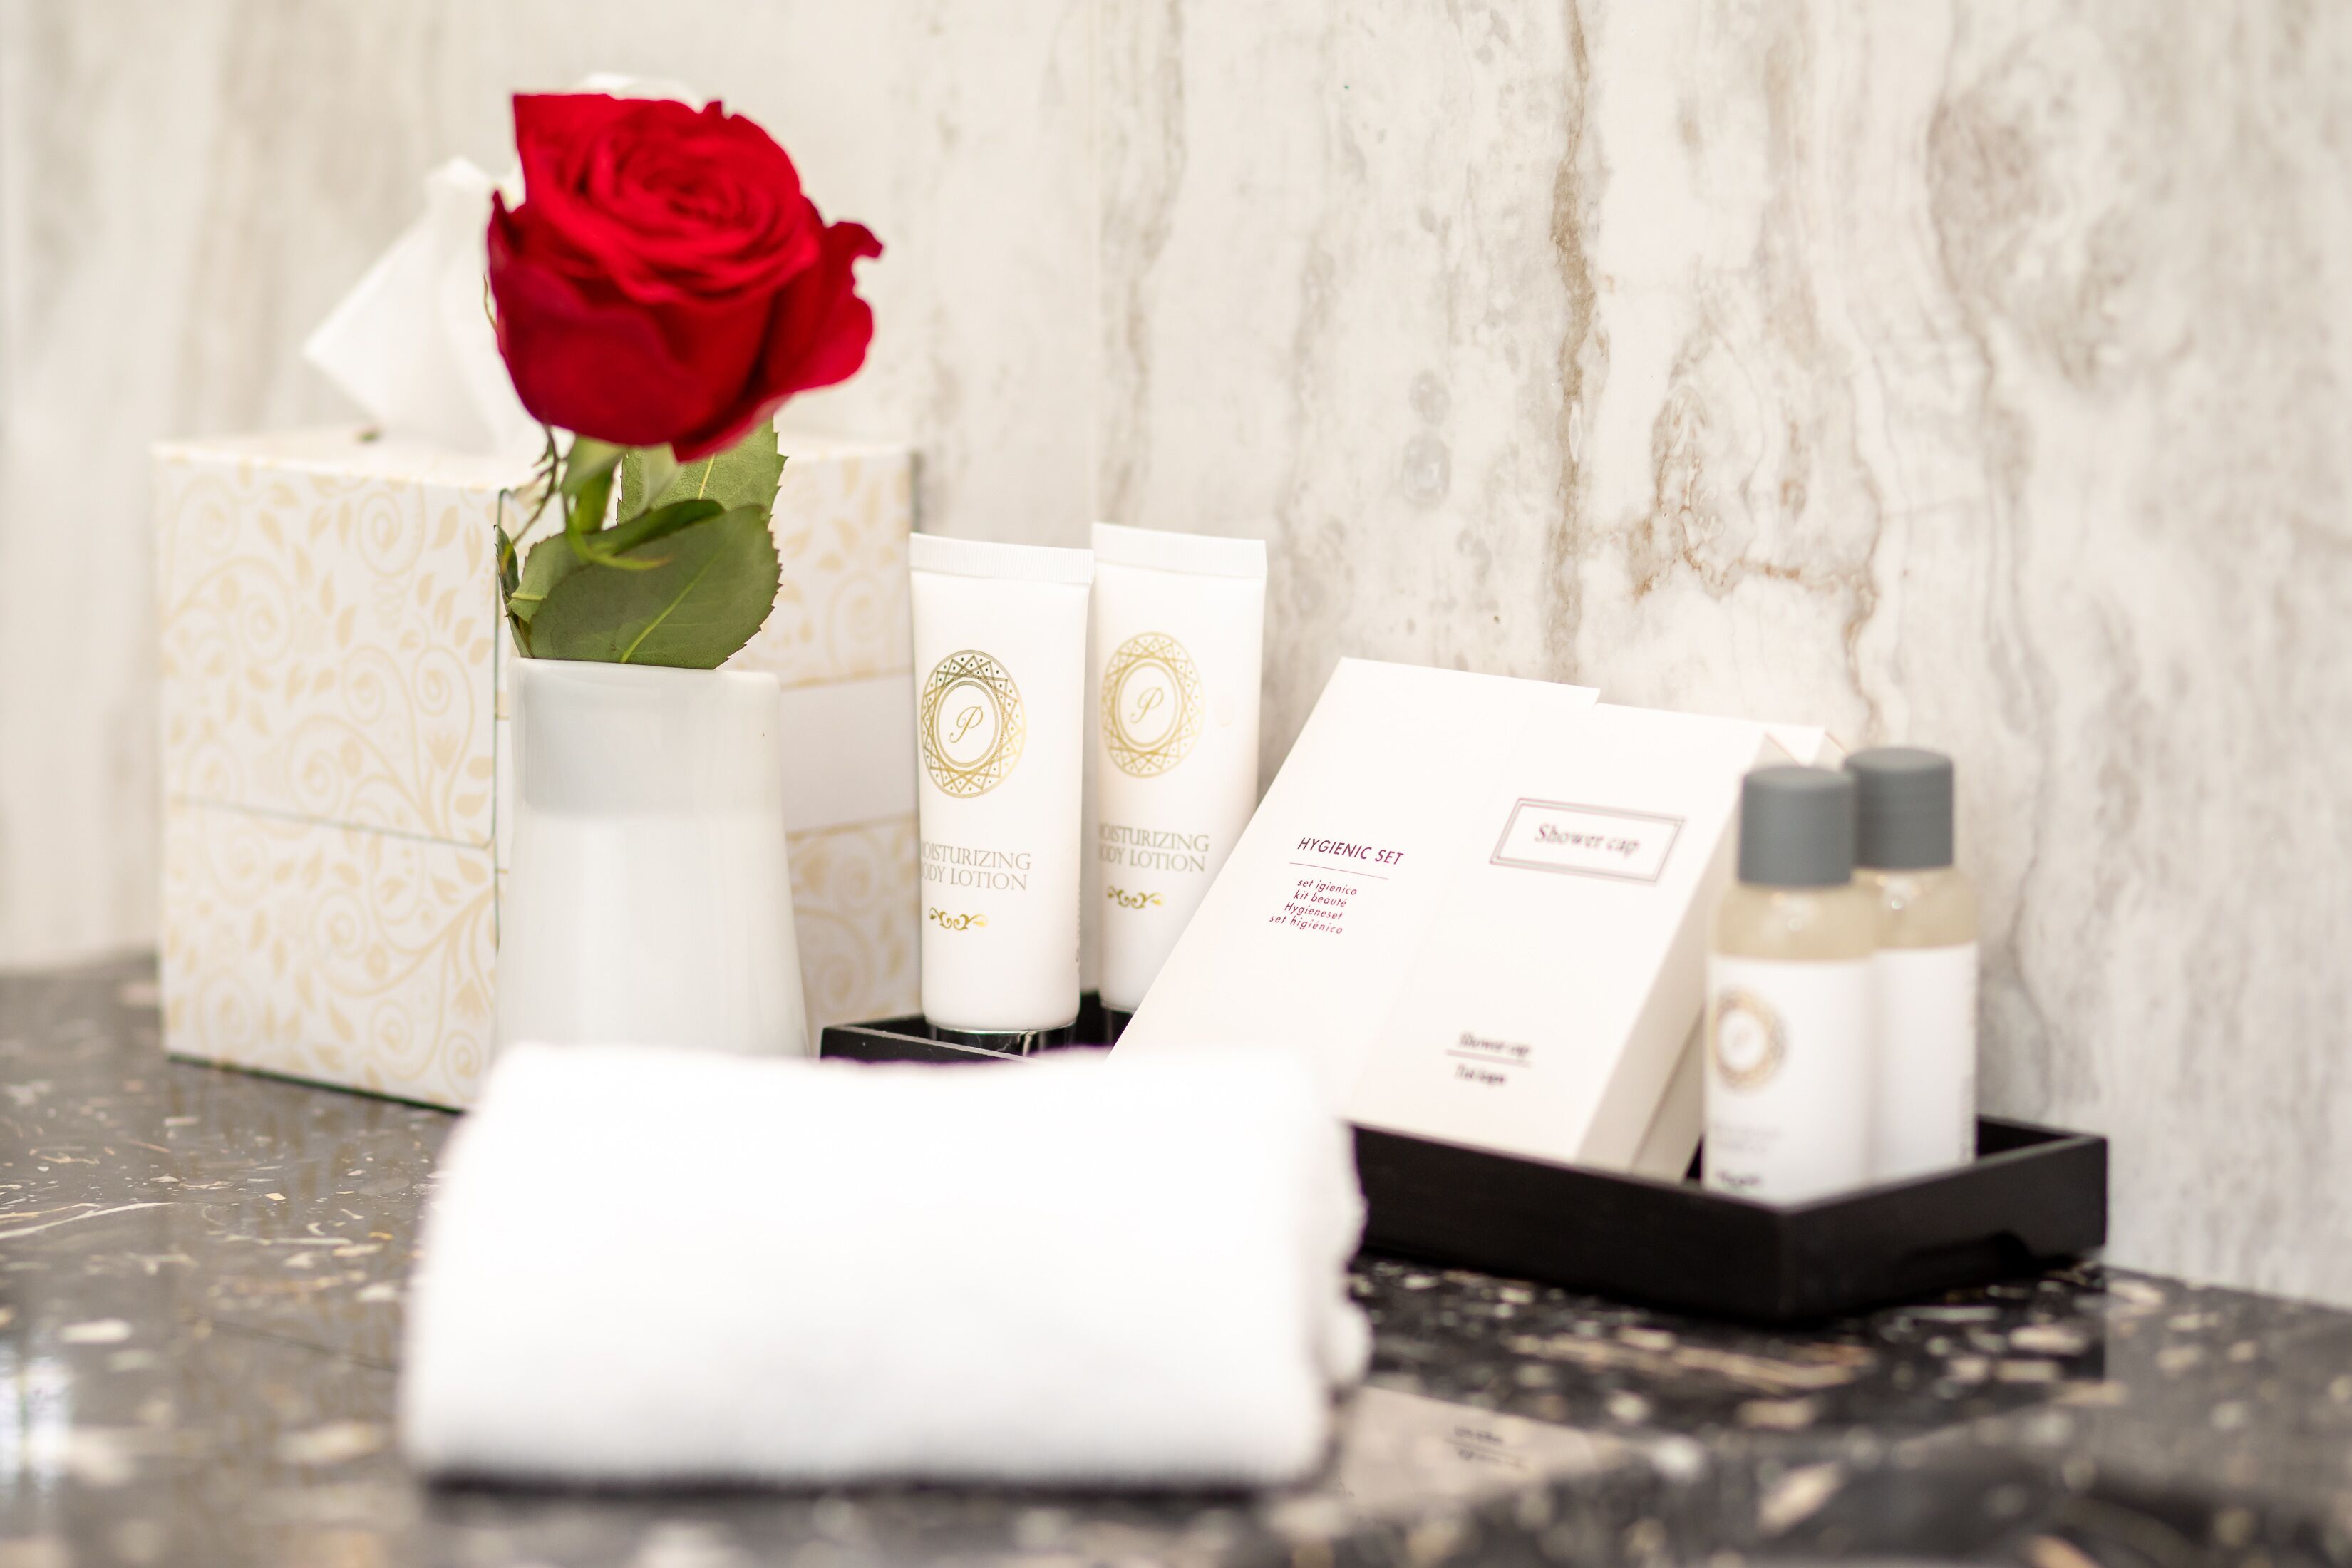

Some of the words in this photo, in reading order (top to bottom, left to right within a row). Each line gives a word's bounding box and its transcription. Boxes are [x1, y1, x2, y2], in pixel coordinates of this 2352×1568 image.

[949, 706, 984, 744] P
[1296, 837, 1373, 860] HYGIENIC
[1374, 849, 1405, 865] SET
[1534, 822, 1604, 850] Shower
[1606, 837, 1641, 859] cap
[922, 841, 1031, 870] OISTURIZING
[1129, 848, 1207, 873] LOTION
[922, 862, 946, 883] ODY
[950, 867, 1028, 891] LOTION
[1296, 879, 1314, 887] set
[1315, 880, 1358, 896] igienico
[1284, 901, 1343, 920] Hygieneset
[1293, 889, 1309, 900] kit
[1310, 892, 1348, 907] beauté
[1269, 915, 1287, 924] set
[1289, 915, 1343, 935] higiénico
